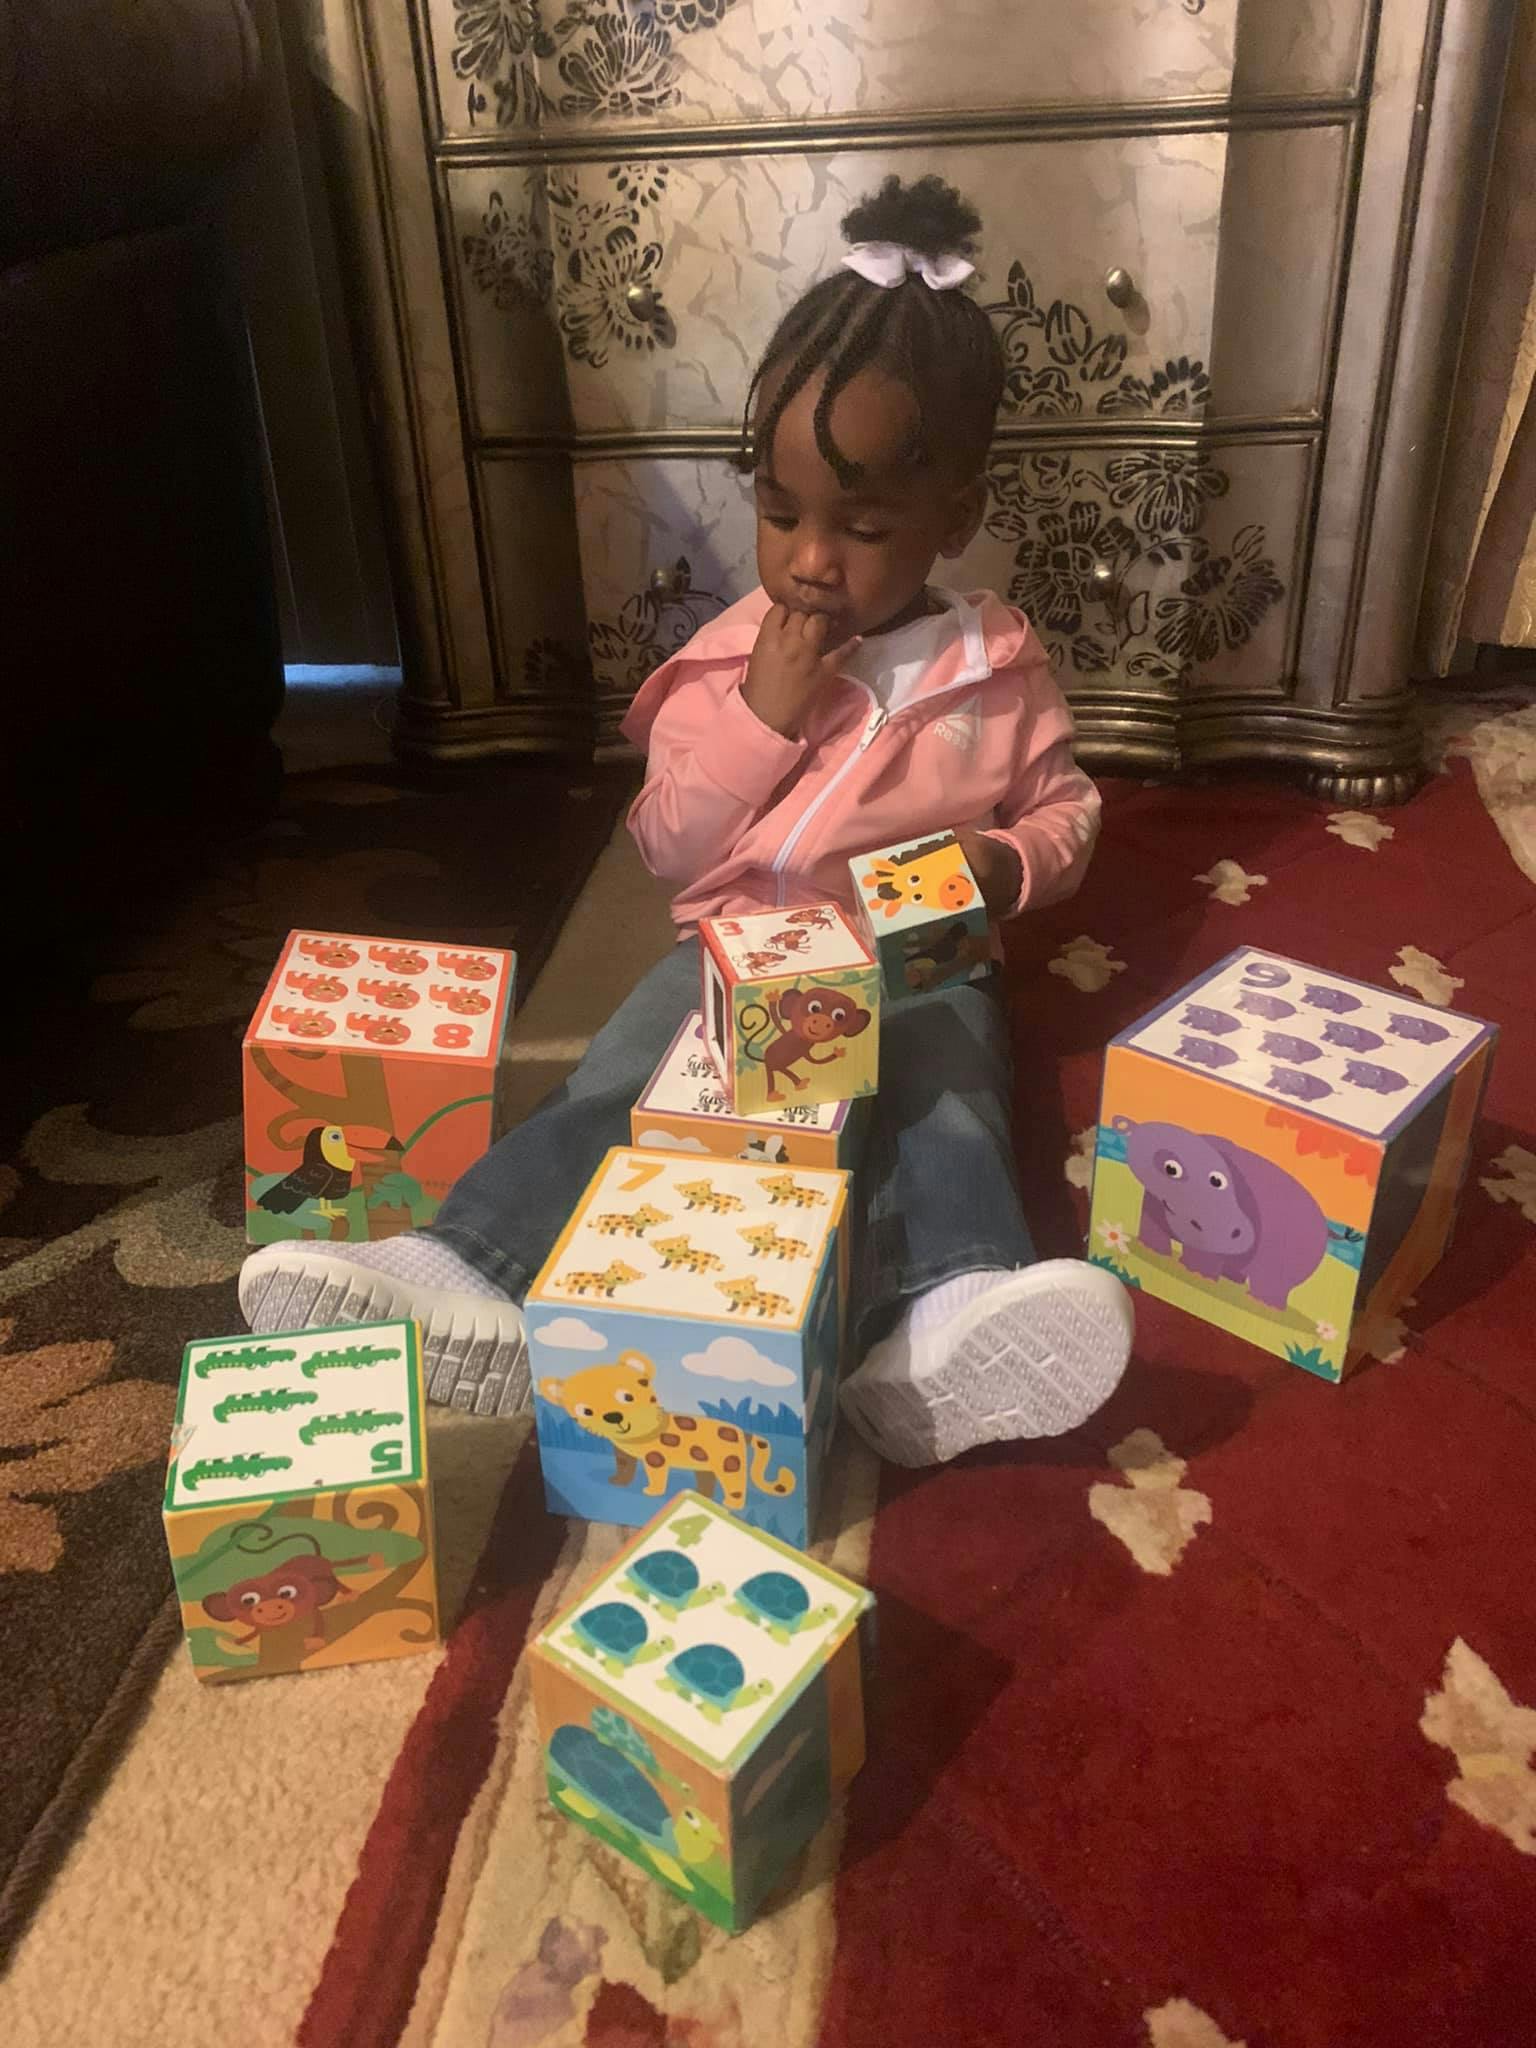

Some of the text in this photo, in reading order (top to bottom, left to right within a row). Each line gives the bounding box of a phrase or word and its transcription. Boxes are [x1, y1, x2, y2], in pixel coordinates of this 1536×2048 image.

[718, 921, 744, 936] 3
[1240, 963, 1291, 988] 9
[433, 1023, 473, 1048] 8
[618, 1158, 666, 1191] 7
[370, 1440, 403, 1473] 5
[668, 1514, 713, 1548] 4
